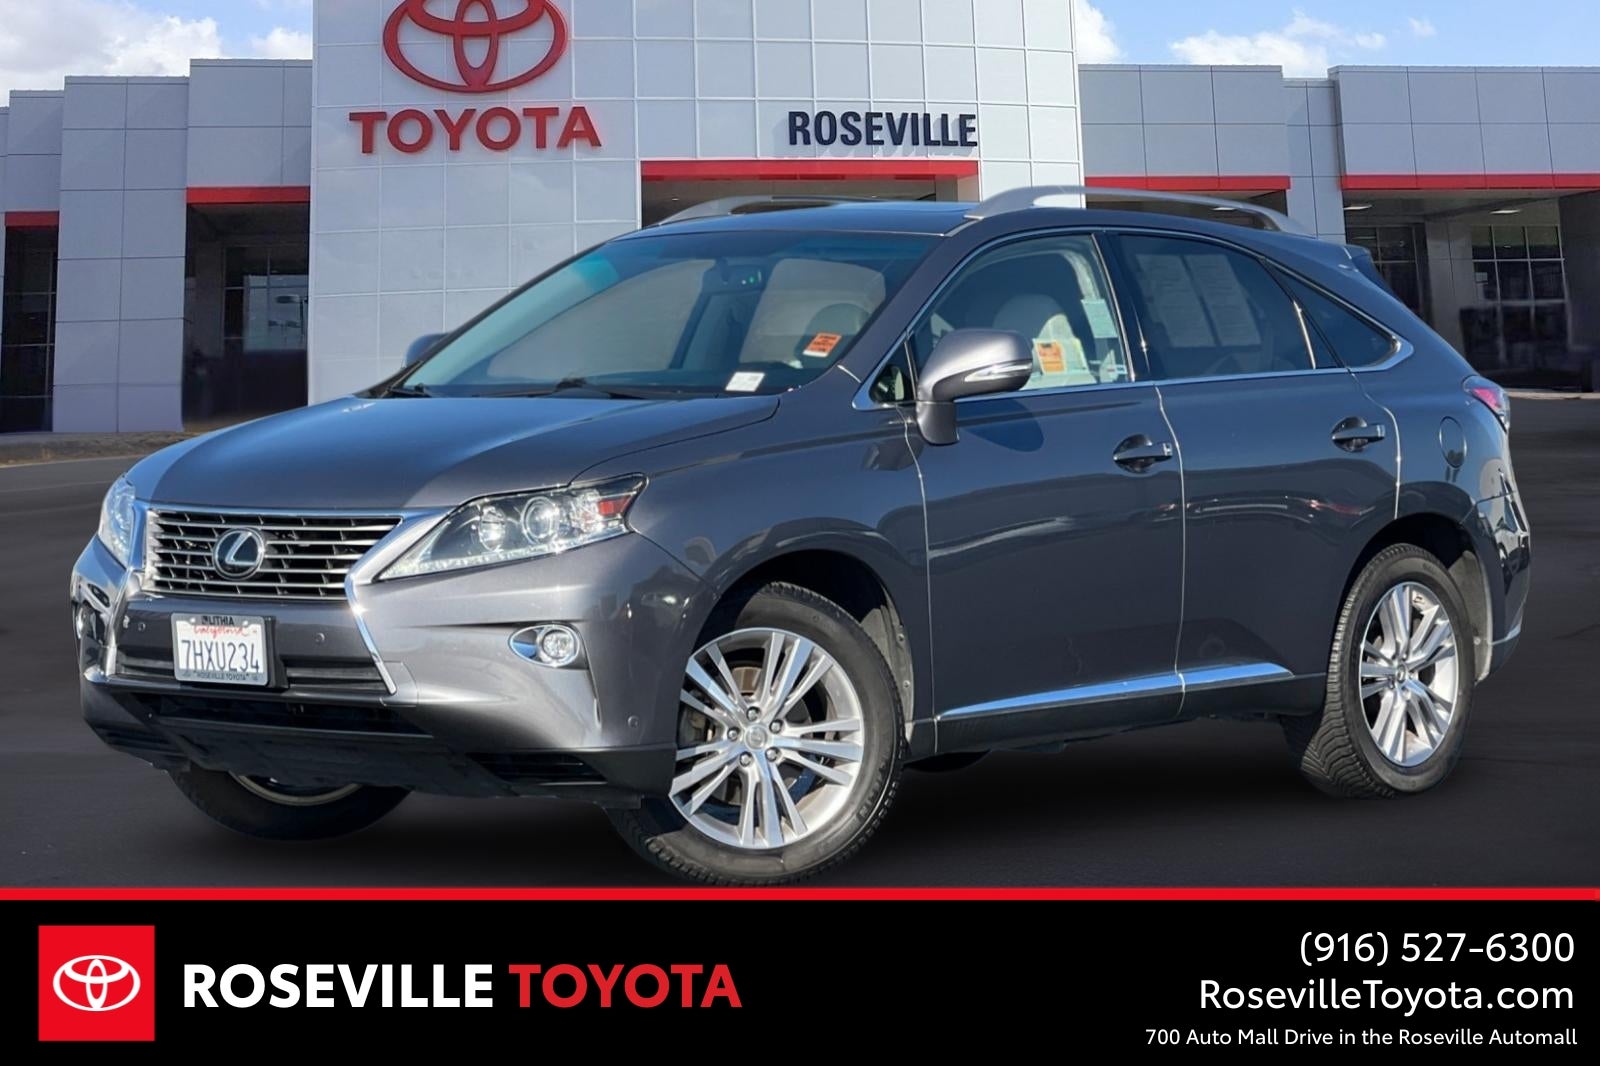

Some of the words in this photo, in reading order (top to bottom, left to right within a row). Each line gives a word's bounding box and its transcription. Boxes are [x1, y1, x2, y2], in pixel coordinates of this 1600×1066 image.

[349, 106, 602, 153] TOYOTA
[788, 111, 978, 146] ROSEVILLE
[181, 640, 260, 674] 7HXU234
